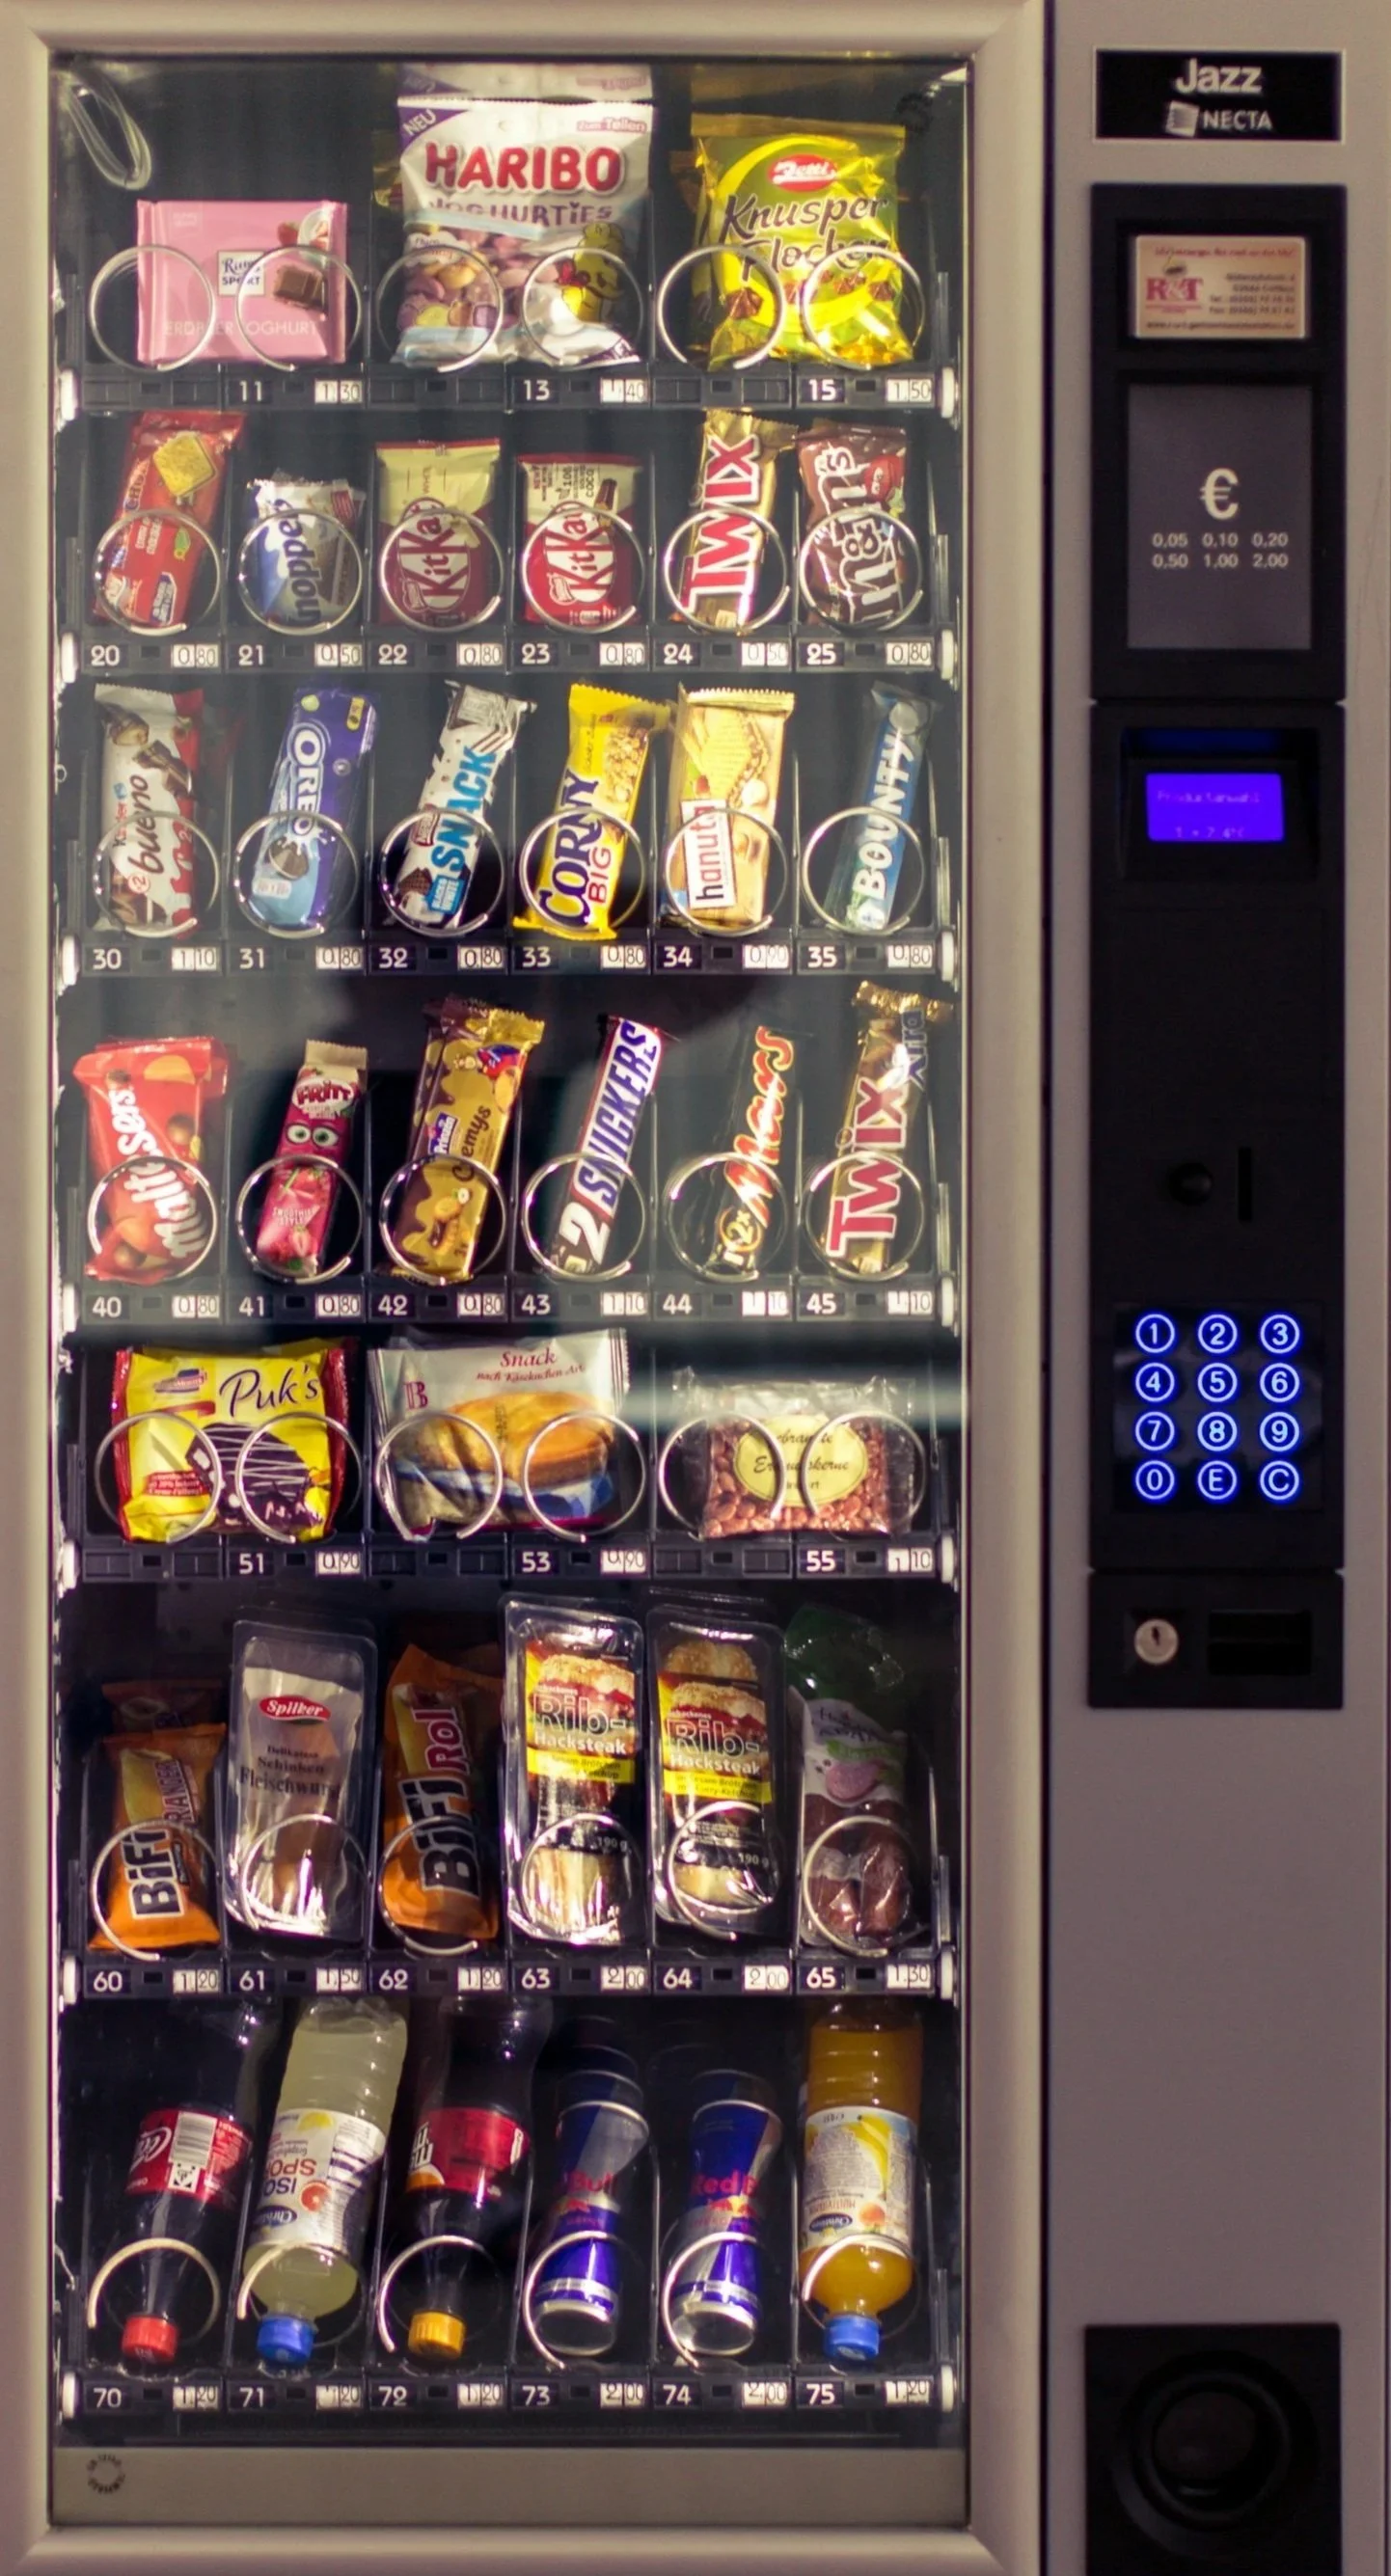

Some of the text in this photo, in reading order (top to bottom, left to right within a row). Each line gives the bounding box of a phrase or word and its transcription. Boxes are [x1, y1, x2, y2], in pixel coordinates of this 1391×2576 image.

[1174, 57, 1263, 95] Jazz
[401, 107, 437, 137] NEU
[1202, 109, 1273, 131] NECTA
[423, 140, 622, 193] HARIBO
[721, 195, 890, 246] Knusper
[1144, 276, 1204, 302] R&T
[165, 320, 317, 336] ERDBER OGHURT
[239, 380, 263, 402] 11
[522, 379, 552, 401] 13
[807, 378, 837, 398] 15
[1199, 467, 1241, 521] €
[677, 433, 761, 615] TWIX
[90, 643, 121, 666] 20
[237, 643, 265, 666] 21
[377, 643, 409, 665] 22
[521, 643, 551, 665] 23
[662, 643, 695, 665] 24
[805, 643, 837, 665] 25
[292, 728, 323, 836] OREO
[430, 745, 499, 873] SNACK
[851, 732, 915, 901] BOUNTY
[126, 773, 166, 876] bueno
[537, 767, 600, 927] CORNY
[695, 803, 725, 902] hanuta
[586, 846, 613, 905] BIG
[92, 947, 123, 970] 30
[238, 947, 265, 969] 31
[378, 946, 408, 969] 32
[522, 945, 552, 968] 33
[662, 945, 694, 968] 34
[806, 945, 838, 968] 35
[576, 1018, 659, 1211] SNICKERS
[452, 1104, 493, 1182] Cemys
[559, 1200, 610, 1266] 2
[91, 1295, 123, 1318] 40
[237, 1294, 265, 1317] 41
[377, 1294, 409, 1316] 42
[520, 1293, 552, 1315] 43
[662, 1293, 693, 1315] 44
[805, 1292, 837, 1315] 45
[1147, 1321, 1159, 1346] 1
[1210, 1321, 1225, 1346] 2
[1272, 1321, 1288, 1346] 3
[500, 1346, 557, 1369] Snack
[218, 1363, 321, 1418] Puk's
[1145, 1370, 1160, 1396] 4
[1210, 1370, 1225, 1396] 5
[1272, 1370, 1288, 1396] 6
[1145, 1419, 1160, 1444] 7
[1210, 1419, 1225, 1444] 8
[1272, 1419, 1288, 1444] 9
[1146, 1468, 1160, 1493] 0
[1208, 1468, 1223, 1493] E
[1271, 1468, 1289, 1493] C
[238, 1552, 265, 1574] 51
[521, 1550, 552, 1573] 53
[805, 1549, 837, 1572] 55
[266, 1698, 324, 1718] Spilker
[532, 1693, 627, 1737] Rib-
[534, 1728, 627, 1756] Hacksteak
[666, 1718, 760, 1759] Rib-
[669, 1753, 761, 1776] Hacksteak
[93, 1969, 123, 1993] 60
[238, 1969, 266, 1992] 61
[378, 1968, 410, 1991] 62
[521, 1967, 552, 1991] 63
[662, 1966, 694, 1990] 64
[805, 1966, 837, 1990] 65
[265, 2156, 317, 2177] SPO
[93, 2387, 123, 2408] 70
[238, 2385, 266, 2407] 71
[377, 2385, 408, 2407] 72
[521, 2384, 552, 2406] 73
[662, 2383, 693, 2405] 74
[806, 2383, 837, 2404] 75
